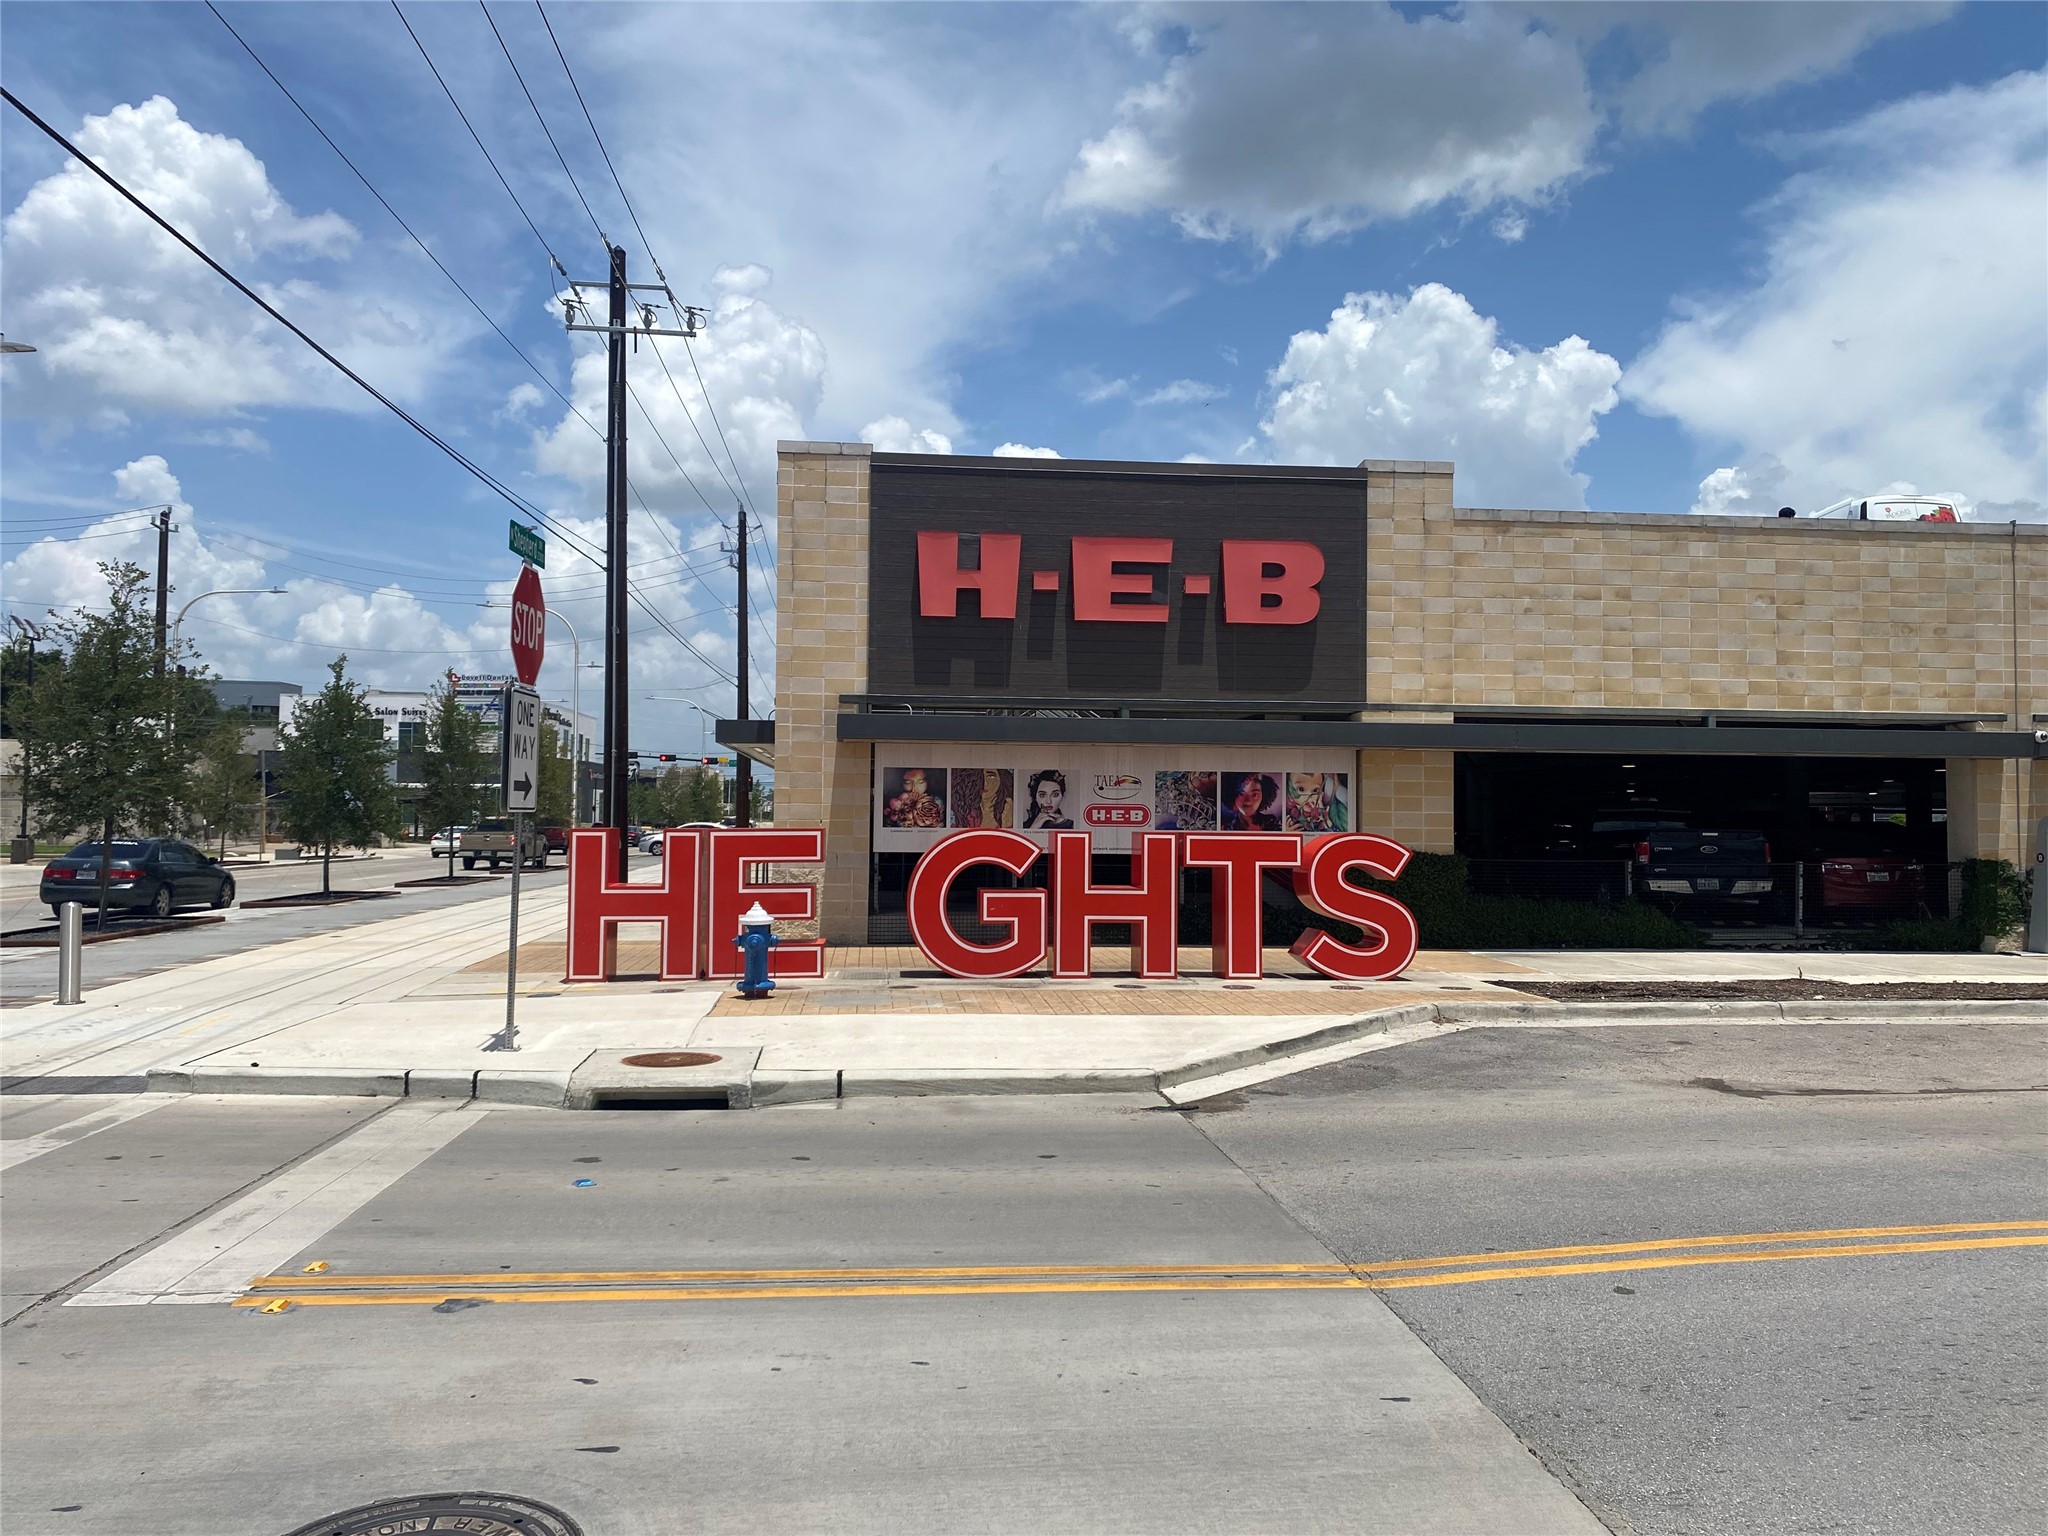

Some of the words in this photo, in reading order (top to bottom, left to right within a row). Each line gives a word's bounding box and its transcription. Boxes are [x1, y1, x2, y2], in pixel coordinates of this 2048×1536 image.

[514, 600, 543, 650] STOP
[517, 700, 535, 728] ONE
[514, 733, 536, 760] WAY
